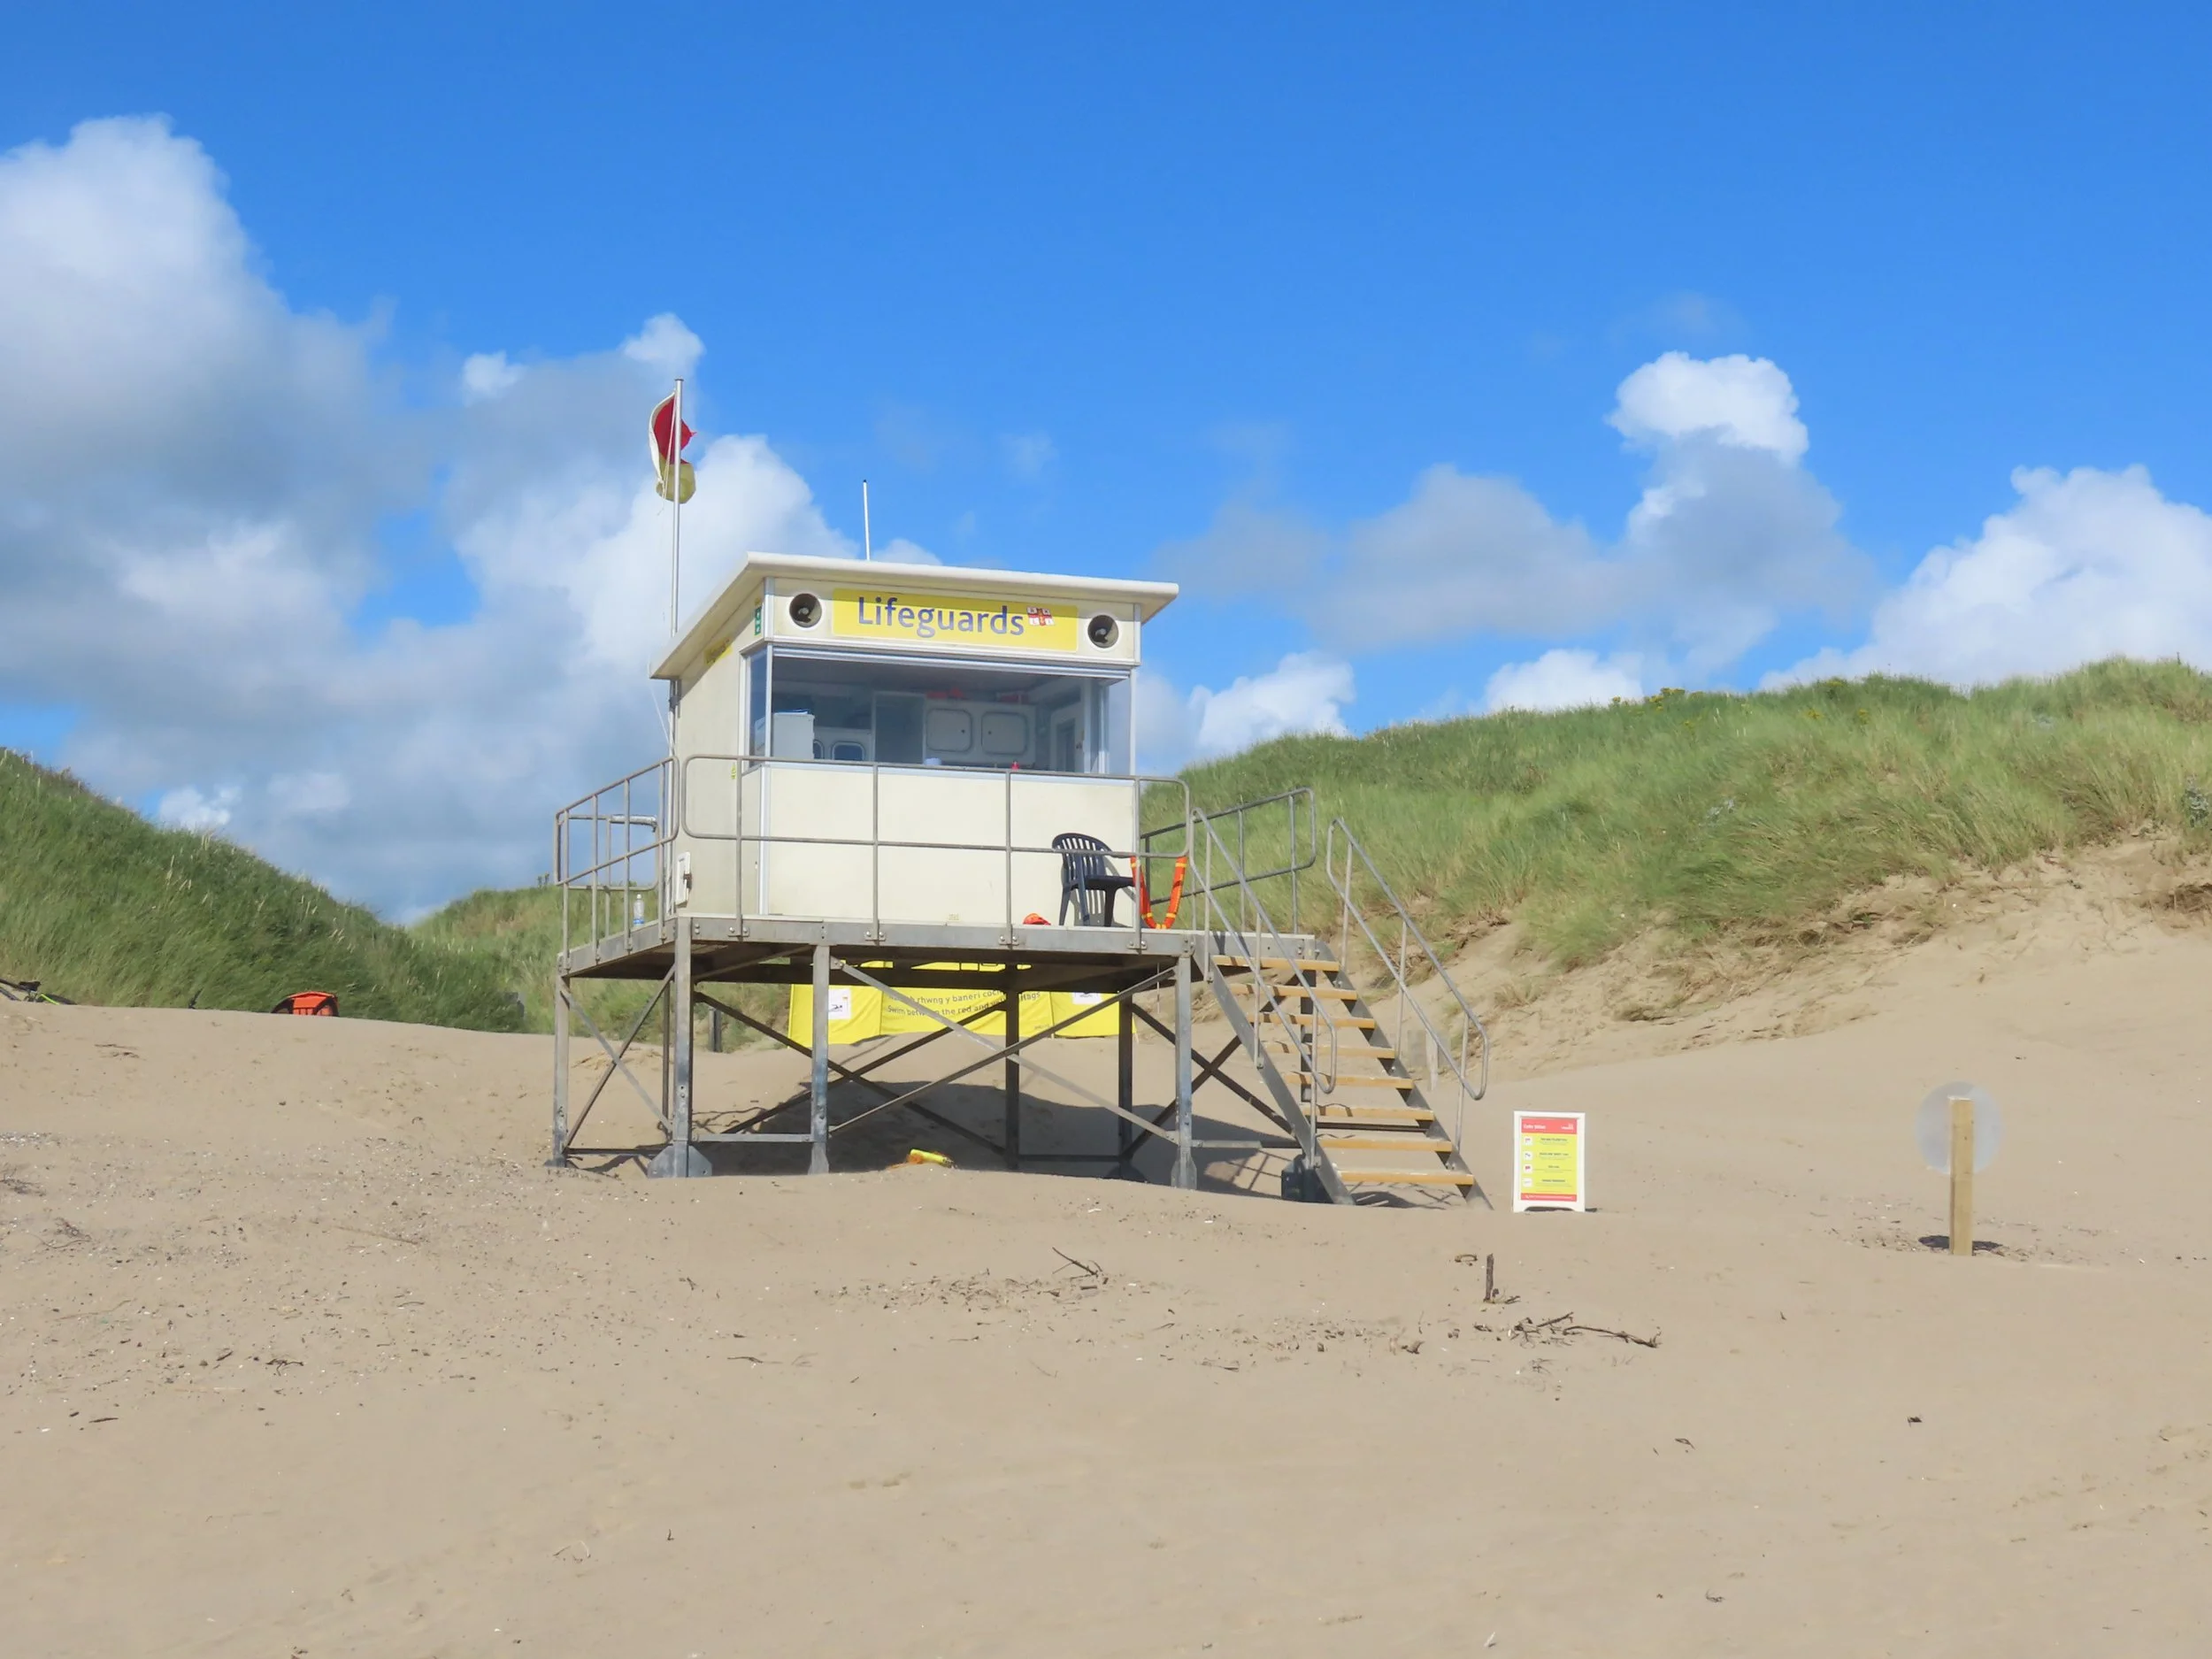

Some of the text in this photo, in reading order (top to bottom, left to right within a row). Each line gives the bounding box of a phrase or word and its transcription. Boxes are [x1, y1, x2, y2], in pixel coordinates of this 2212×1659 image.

[858, 596, 1024, 637] Lifeguards
[952, 992, 980, 1002] baneri
[887, 1004, 905, 1015] Swim
[957, 1005, 972, 1014] red
